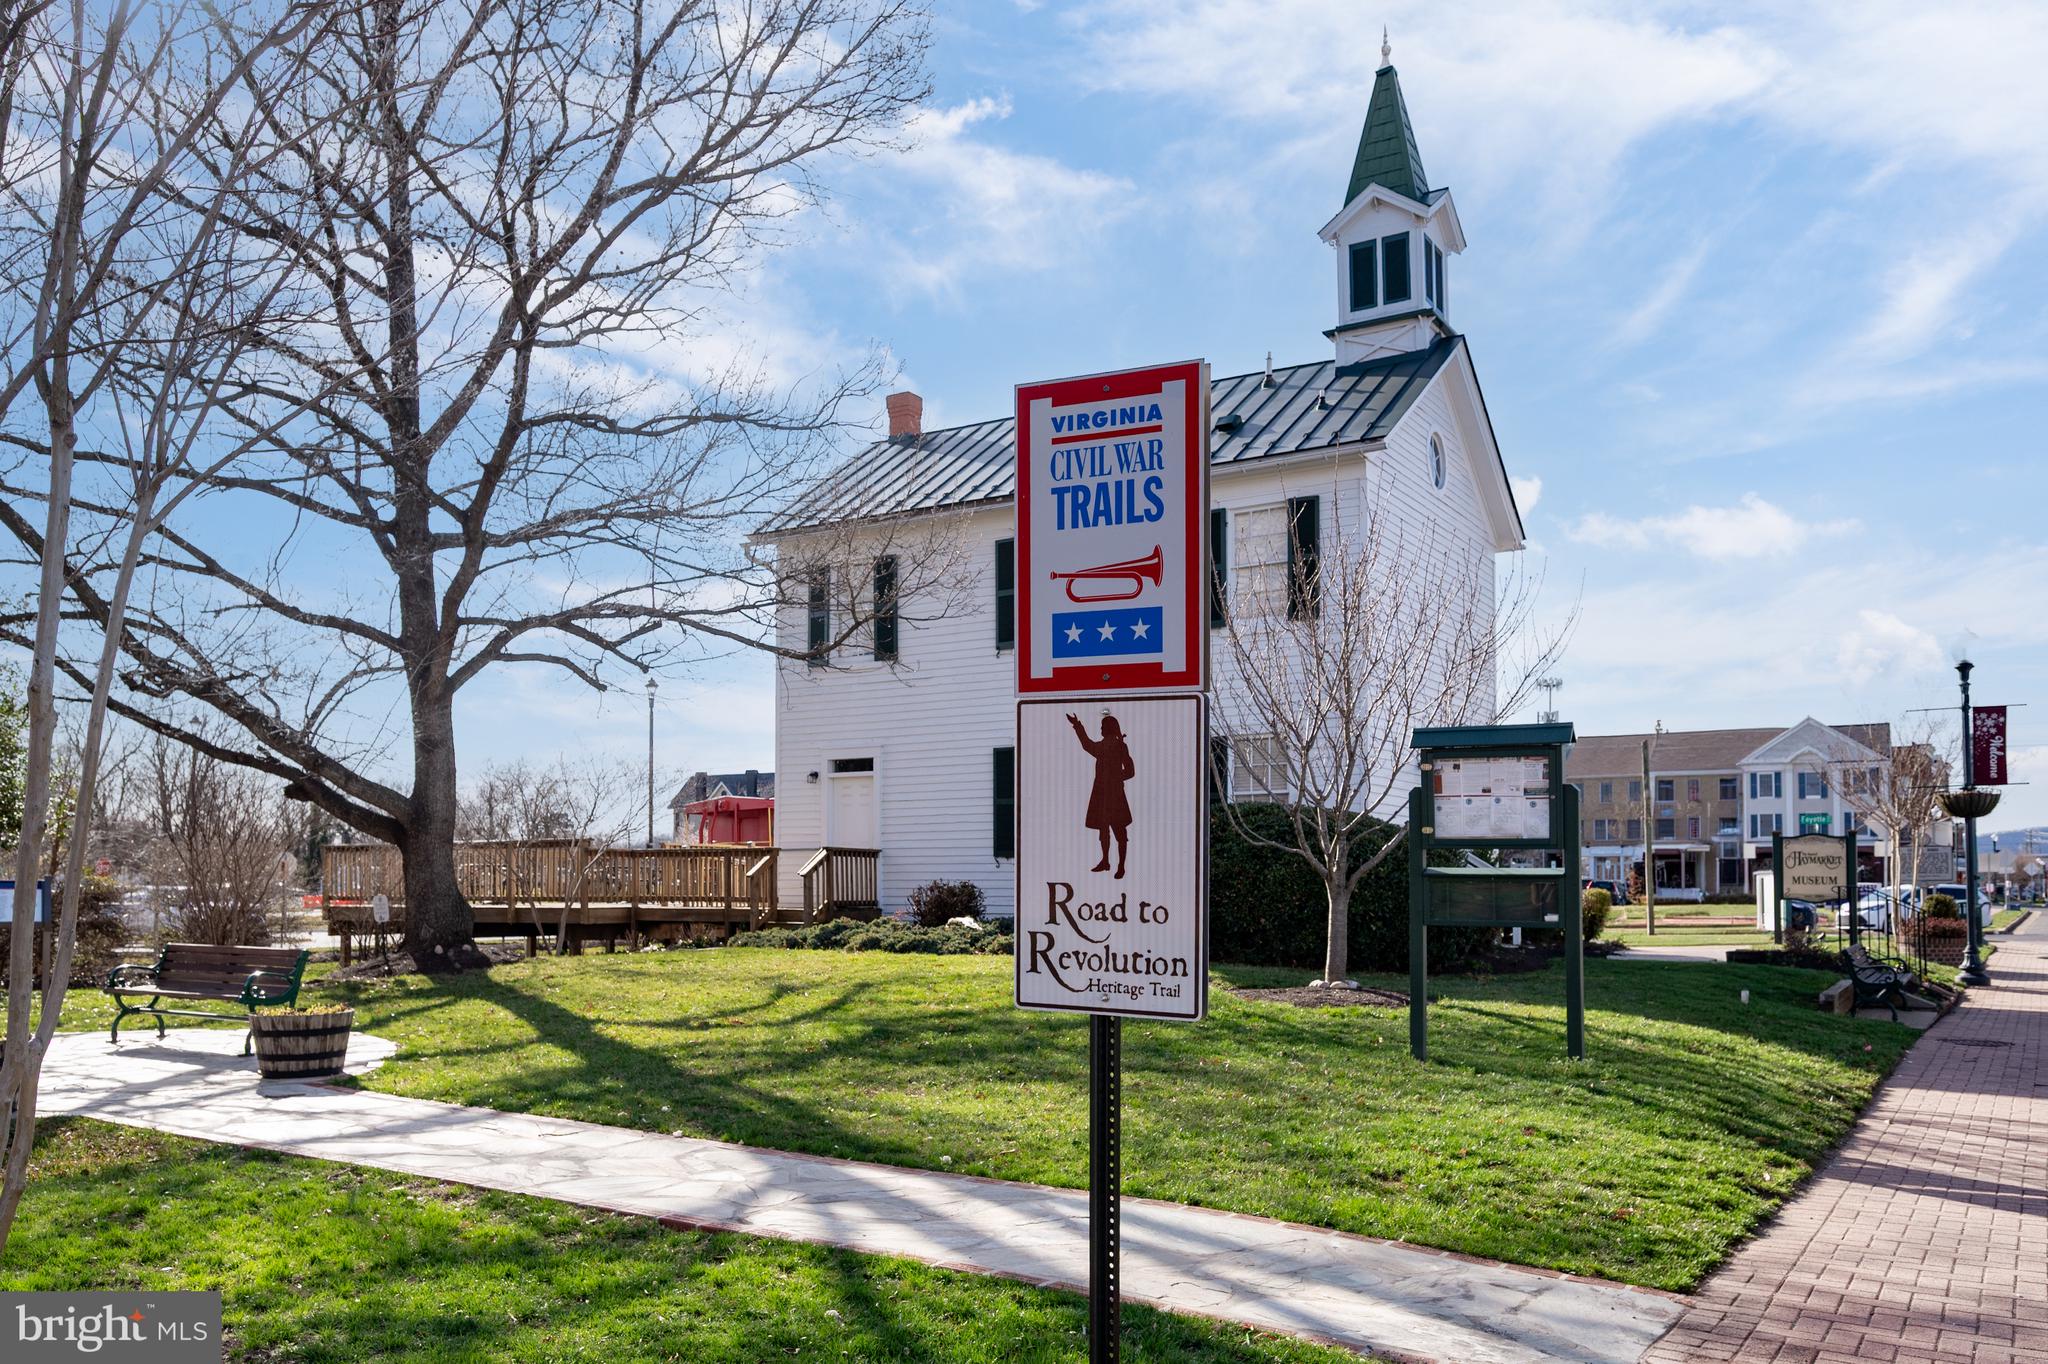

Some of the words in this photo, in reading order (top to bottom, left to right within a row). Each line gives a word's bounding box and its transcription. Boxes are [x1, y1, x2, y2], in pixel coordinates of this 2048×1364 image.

[1051, 403, 1163, 433] VIRGINIA
[1050, 445, 1112, 482] CIVIL
[1114, 438, 1165, 474] WAR
[1050, 475, 1165, 531] TRAILS
[1989, 735, 2005, 779] Welcome
[1792, 876, 1838, 885] MUSEUM
[1044, 881, 1128, 943] Road
[1139, 901, 1169, 924] to
[1026, 930, 1189, 993] Revolution
[1088, 978, 1145, 1000] Heritage
[1149, 982, 1181, 998] Trail
